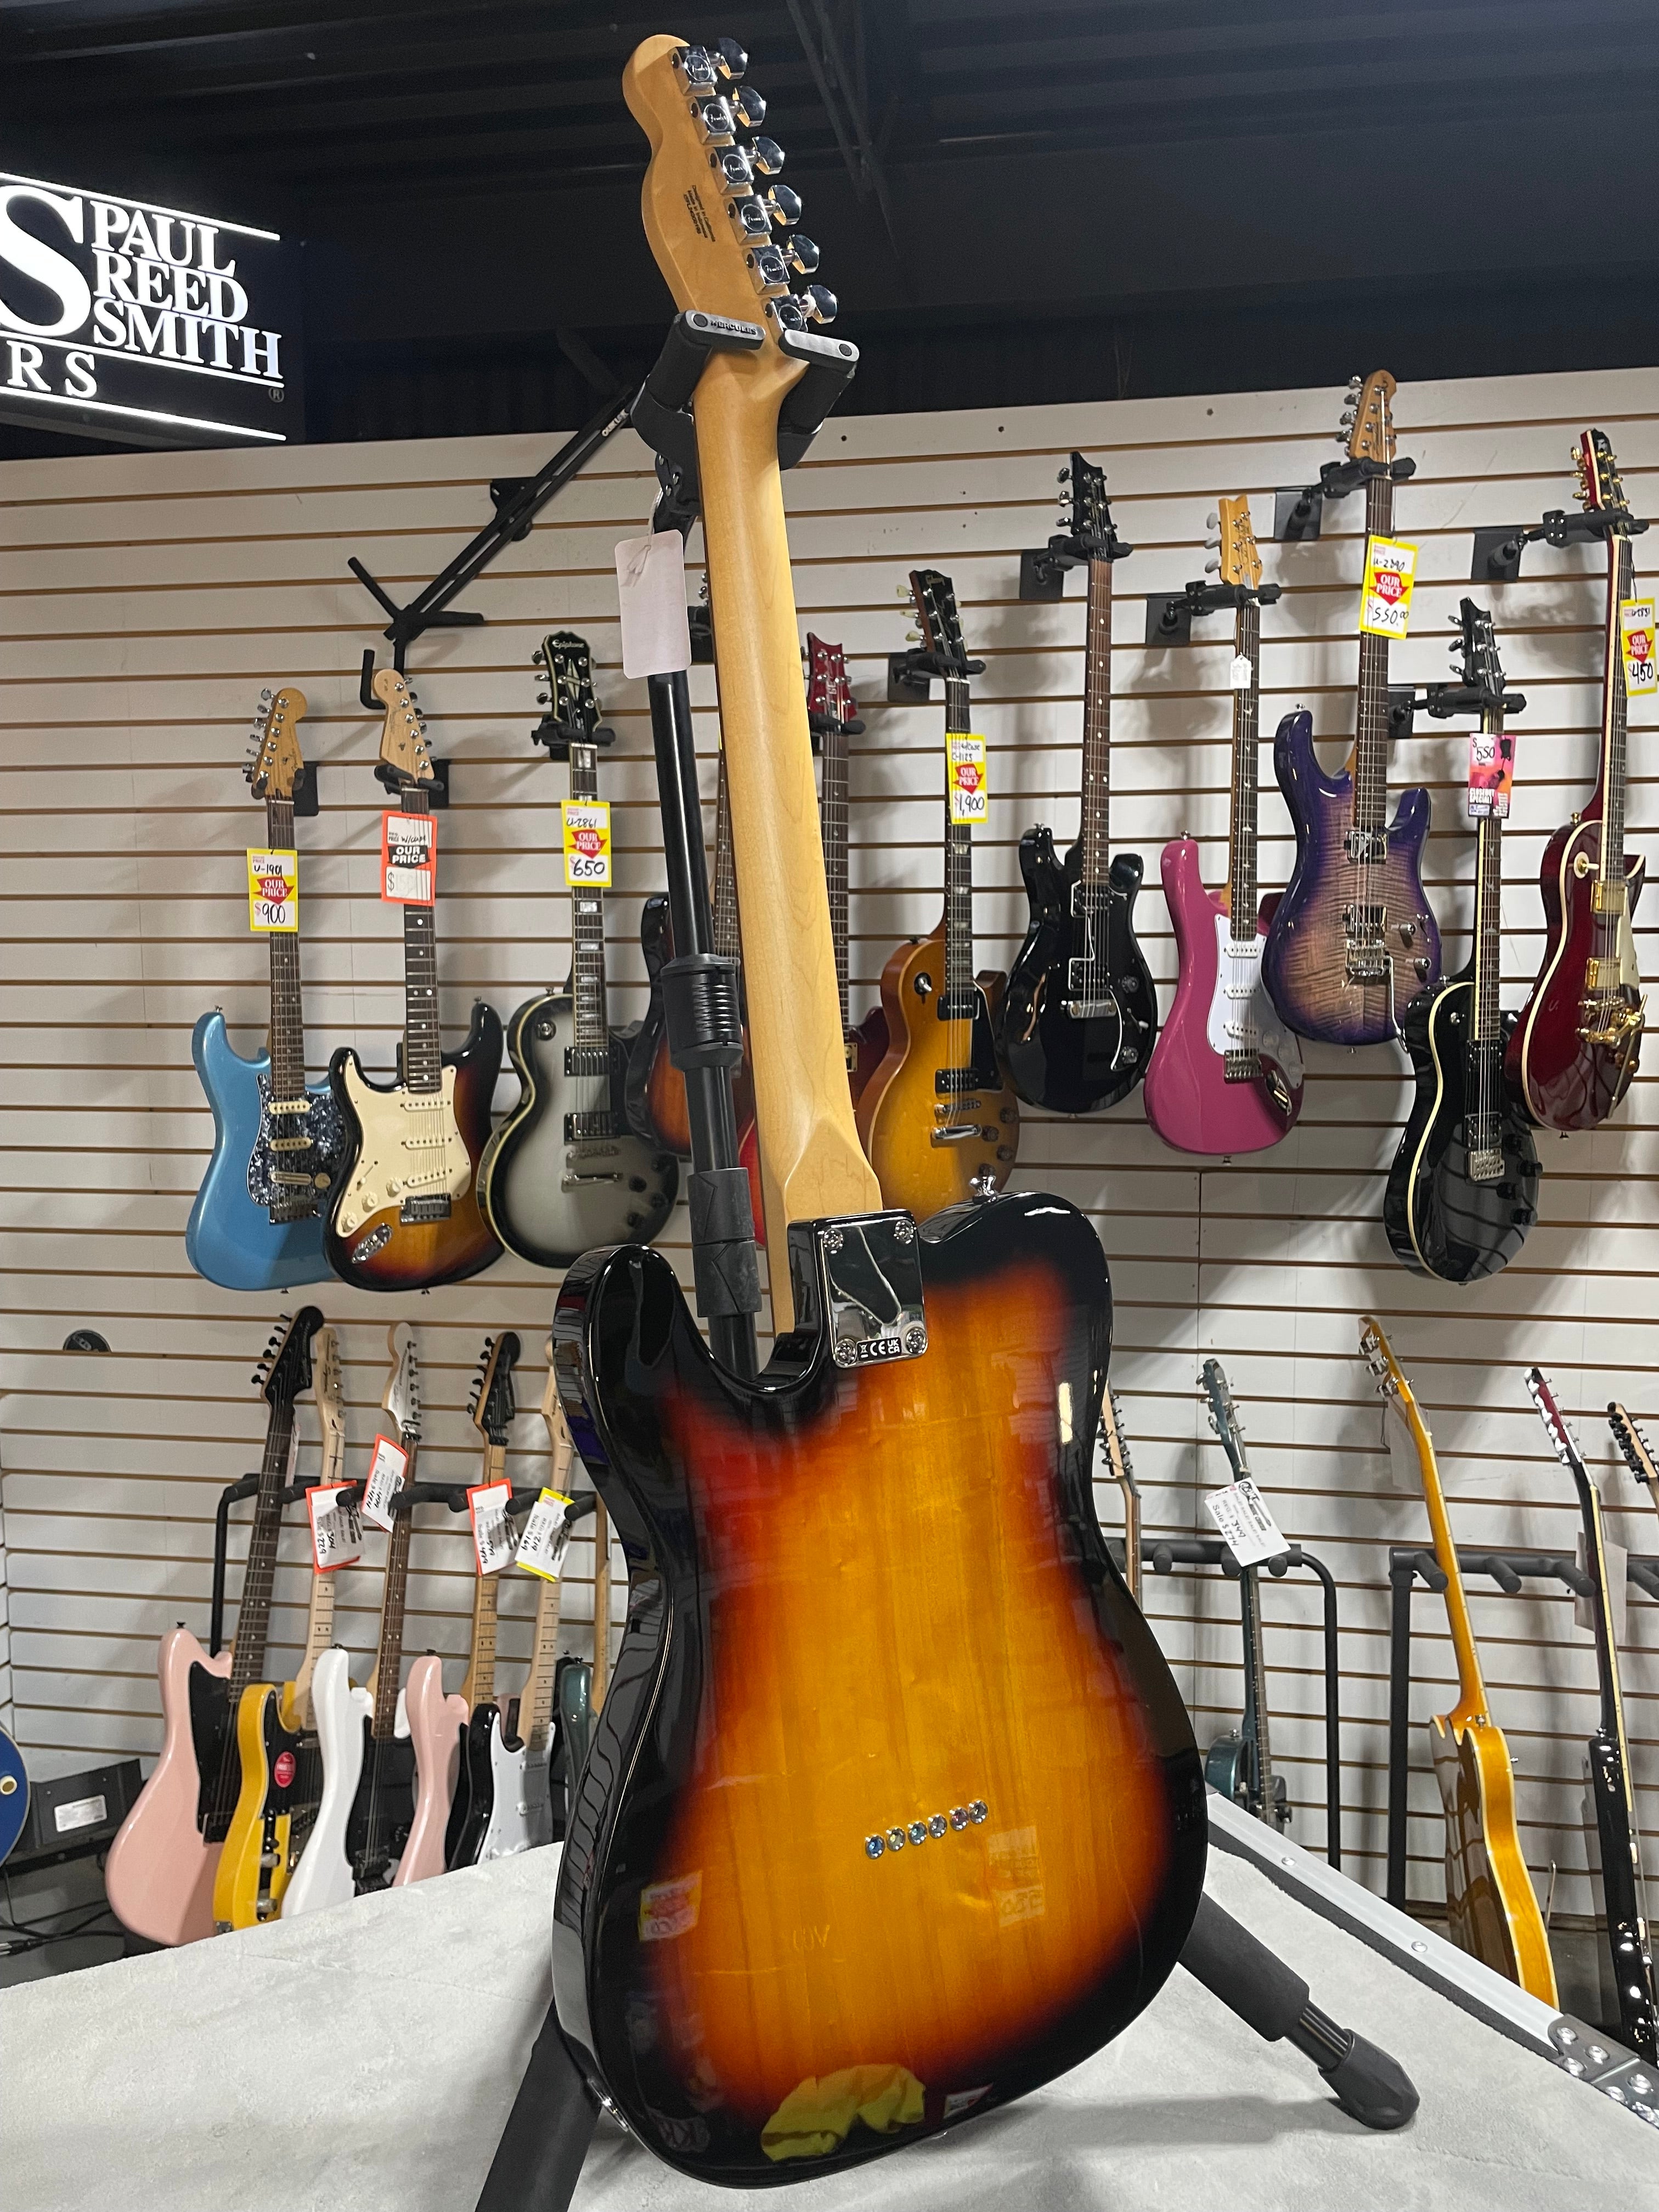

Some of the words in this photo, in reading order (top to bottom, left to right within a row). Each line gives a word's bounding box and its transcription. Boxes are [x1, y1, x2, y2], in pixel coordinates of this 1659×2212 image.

[91, 200, 235, 276] PAUL
[92, 248, 248, 323] REED
[93, 298, 284, 379] SMITH
[1380, 574, 1400, 588] OUR
[1376, 583, 1403, 597] PRICE
[1632, 634, 1646, 645] OUR
[1631, 645, 1649, 656] PRICE
[960, 767, 977, 777] OUR
[959, 776, 979, 786] PRICE
[579, 833, 597, 842] OUR
[576, 841, 601, 850] PRICE
[396, 847, 420, 855] OUR
[392, 854, 426, 864] PRICE
[265, 879, 284, 888] OUR
[262, 888, 287, 897] PRICE
[870, 1341, 886, 1356] CE
[888, 1346, 900, 1354] CA
